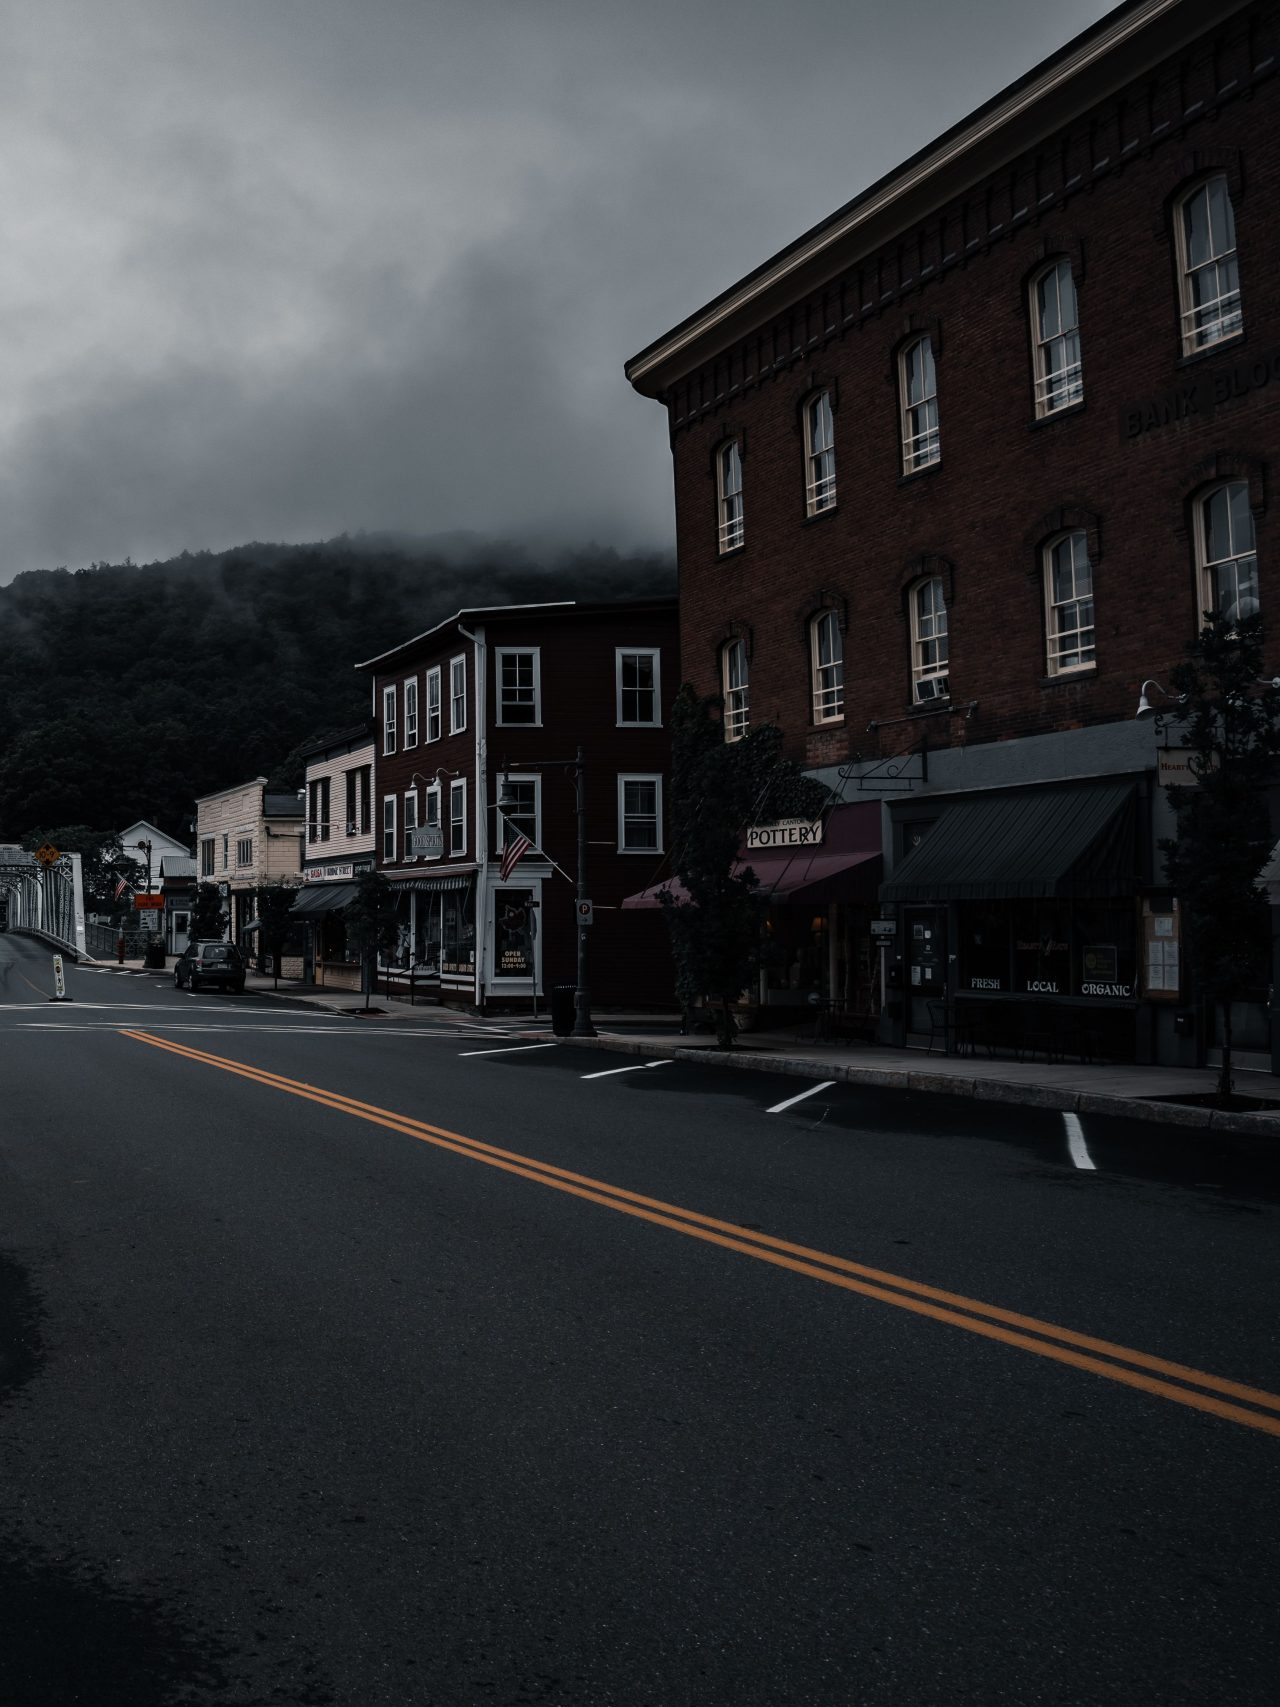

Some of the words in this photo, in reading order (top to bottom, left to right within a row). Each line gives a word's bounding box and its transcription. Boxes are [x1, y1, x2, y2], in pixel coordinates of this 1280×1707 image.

[1126, 385, 1199, 439] BANK
[750, 826, 820, 846] POTTERY
[971, 977, 1001, 989] FRESH
[1027, 981, 1059, 993] LOCAL
[1081, 983, 1131, 997] ORGANIC
